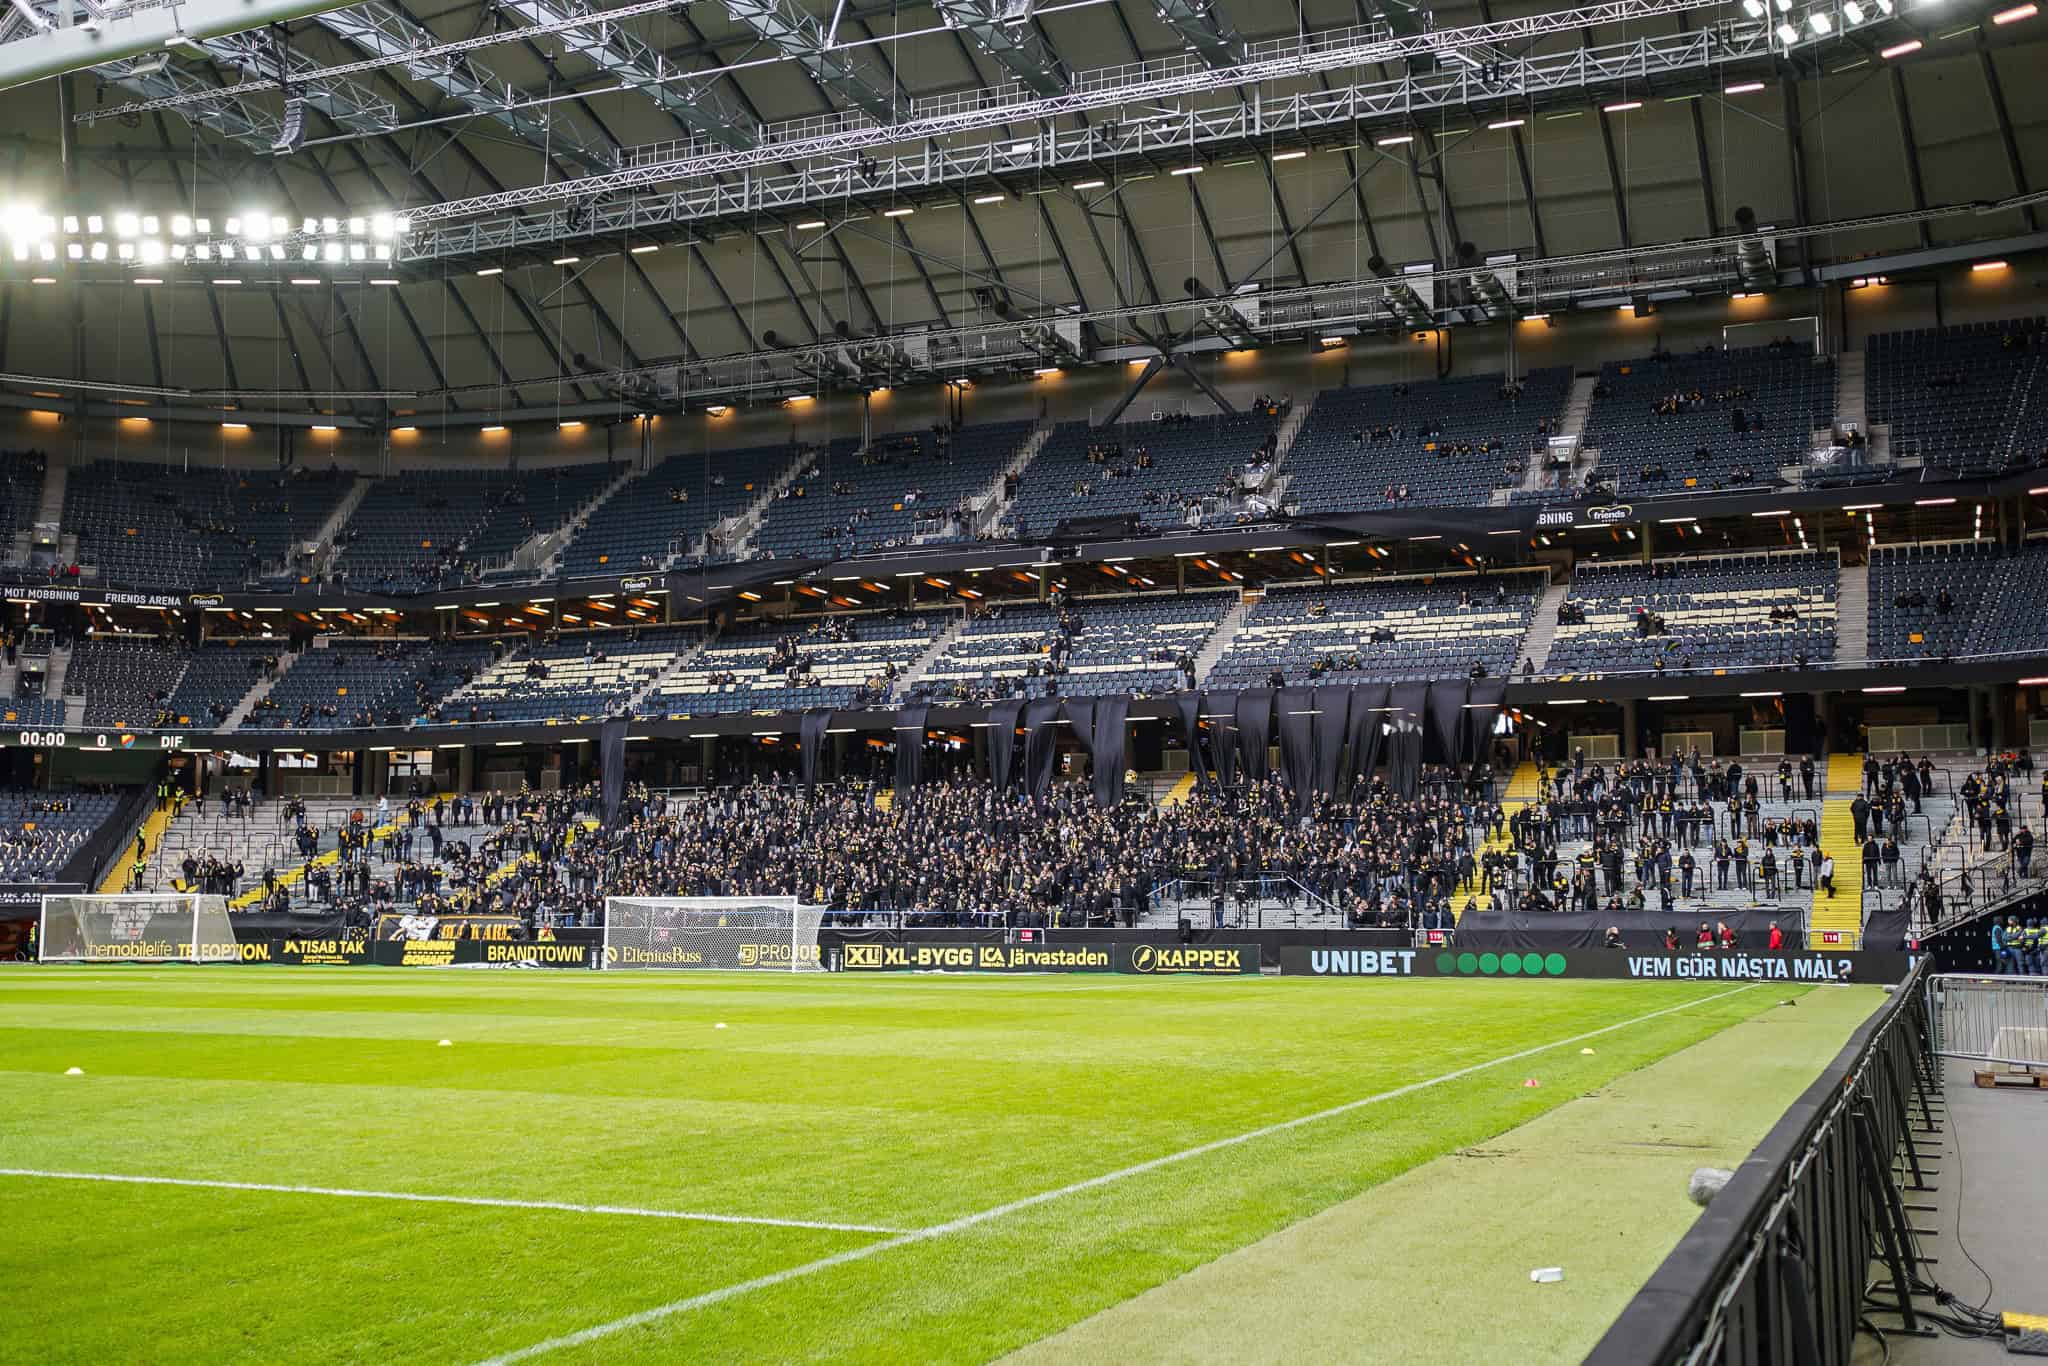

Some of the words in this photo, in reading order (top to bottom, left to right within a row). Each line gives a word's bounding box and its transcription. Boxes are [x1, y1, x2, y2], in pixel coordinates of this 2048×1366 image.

[1536, 511, 1574, 525] BNING
[1593, 510, 1626, 520] friends
[4, 587, 25, 598] MOT
[28, 589, 80, 600] MOBBNING
[105, 592, 146, 604] FRIENDS
[149, 596, 181, 606] ARENA
[193, 597, 218, 606] friends
[20, 732, 65, 746] 00:00
[97, 734, 107, 747] 0
[161, 735, 183, 747] DIF
[339, 941, 365, 953] TAK
[487, 945, 584, 961] BRANDTOWN
[884, 948, 973, 965] XL-BYGG
[980, 947, 1005, 962] ICA
[1008, 947, 1108, 967] Järvastaden
[1157, 950, 1240, 967] KAPPEX
[1312, 951, 1416, 974] UNIBET
[1628, 957, 1671, 976] VEM
[1676, 953, 1715, 977] GÖR
[1722, 953, 1787, 977] NÄSTA
[1794, 954, 1852, 979] MÅL?
